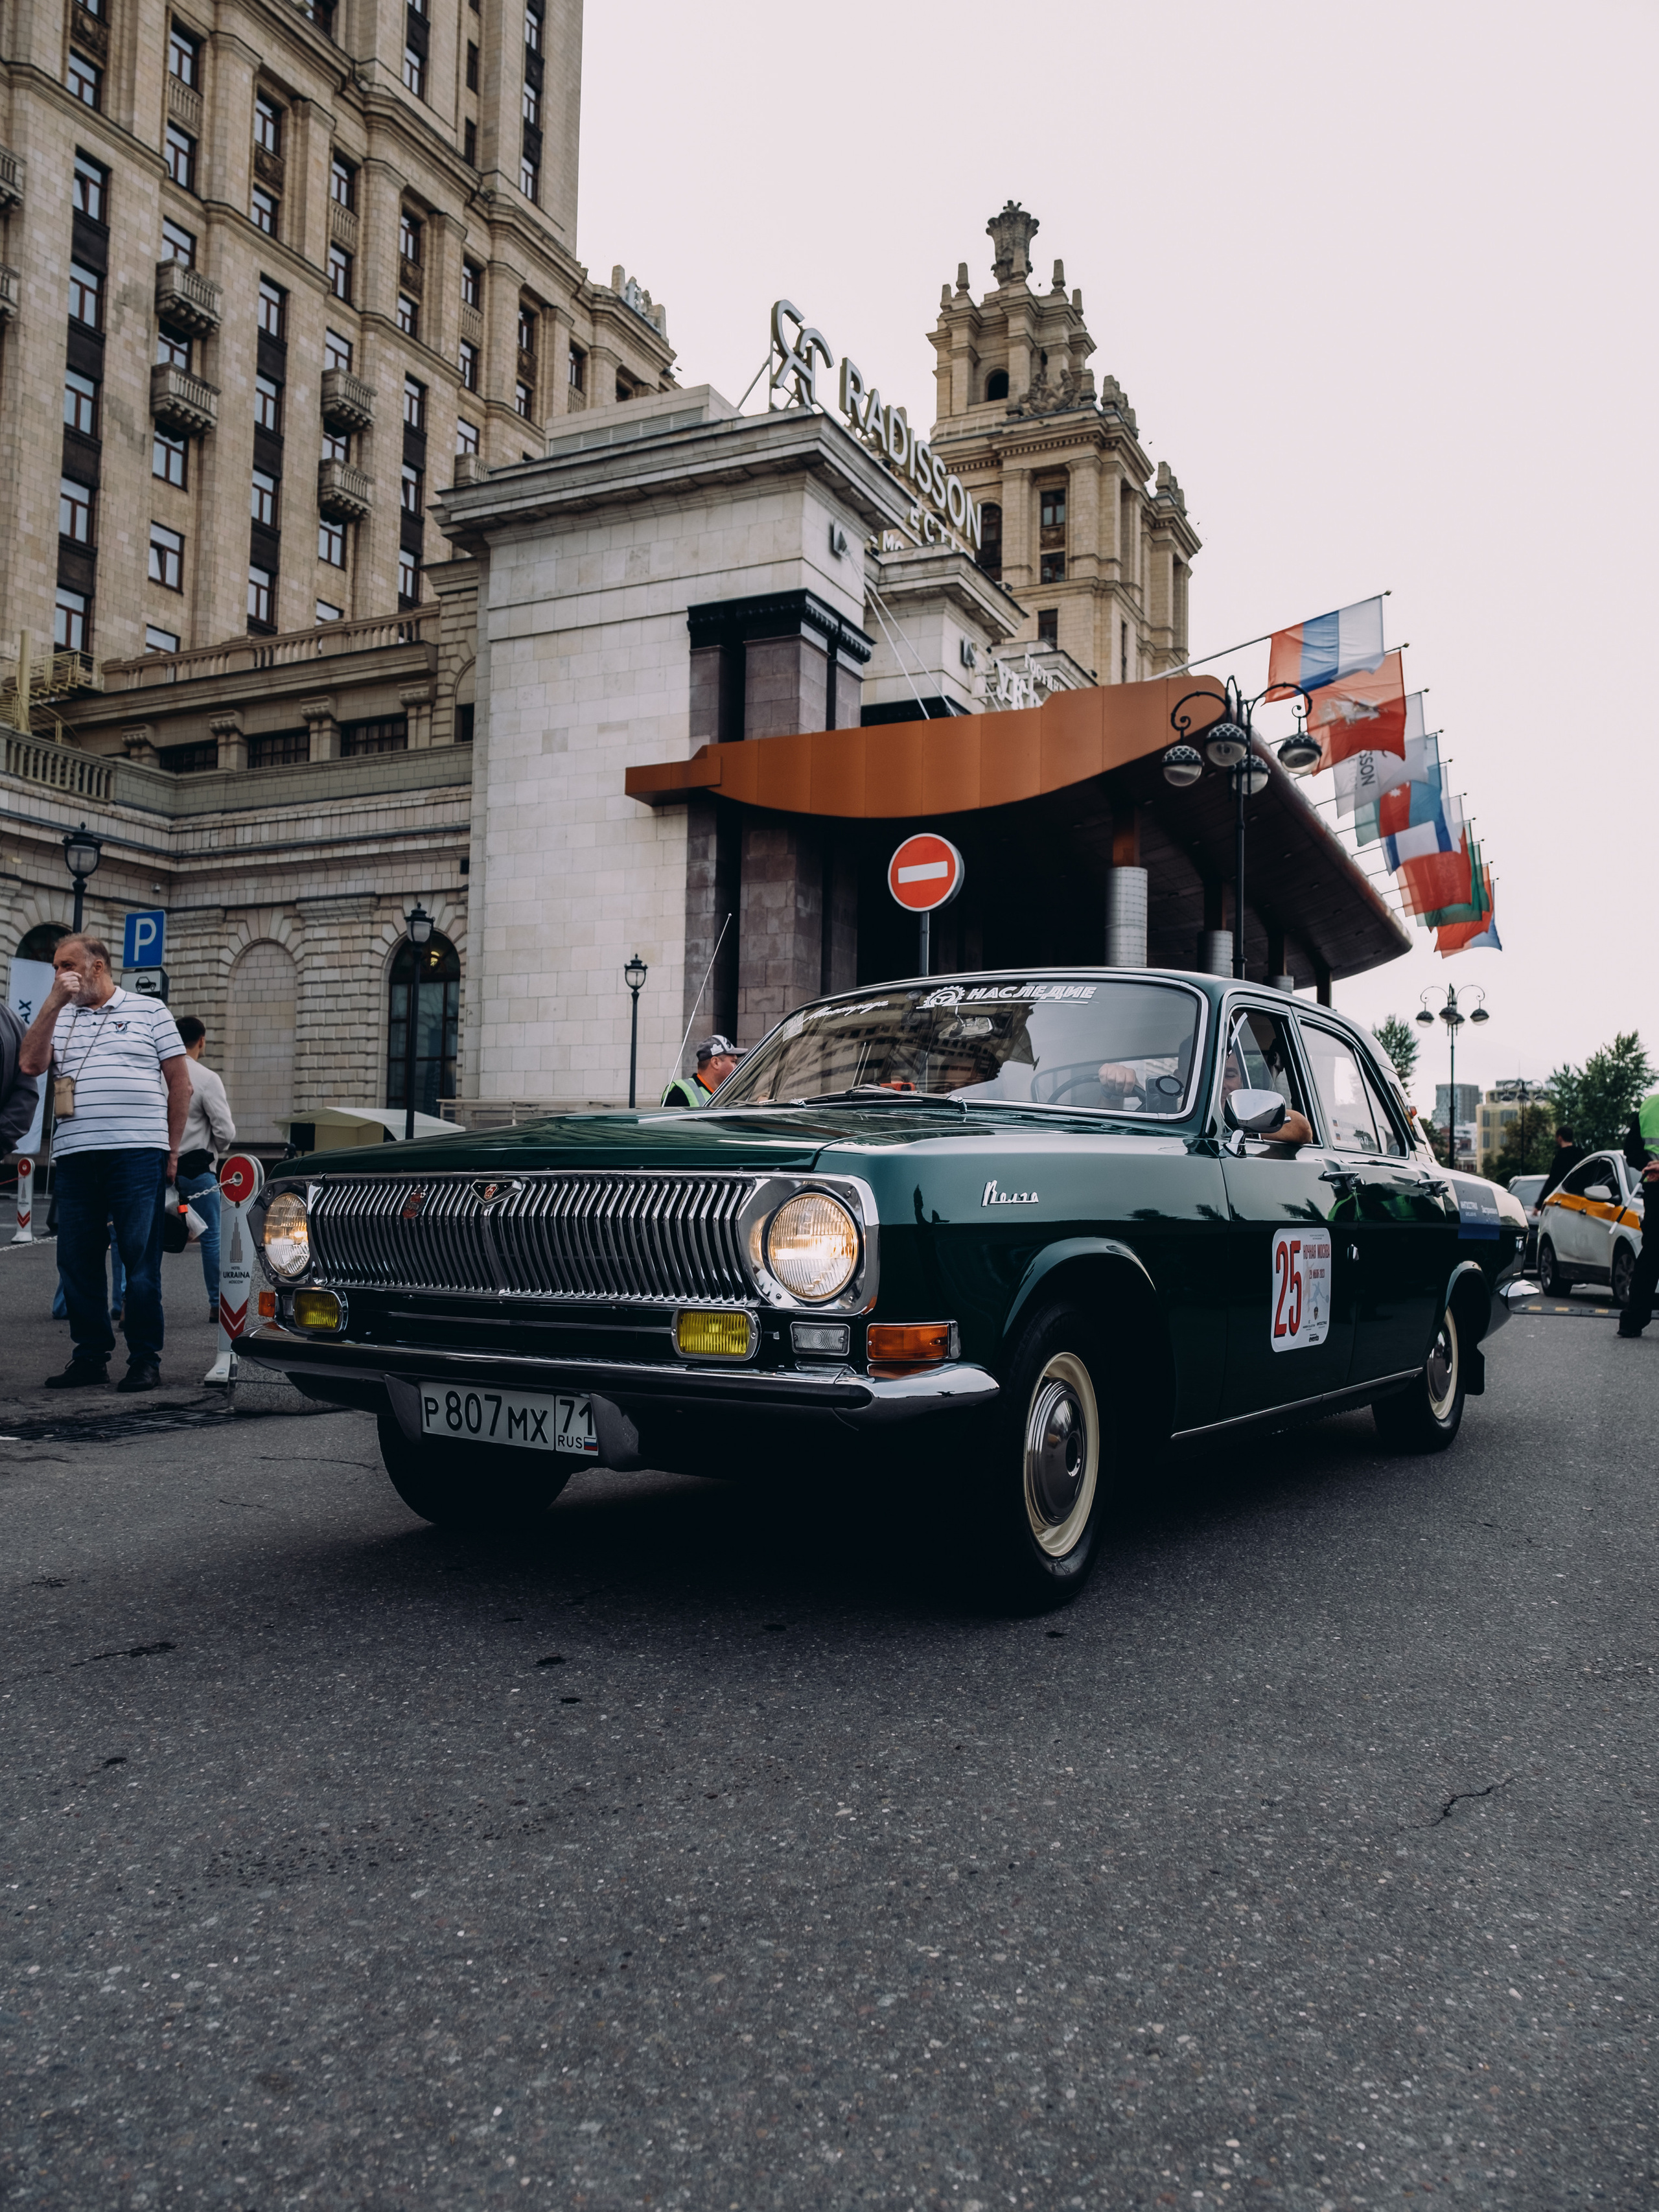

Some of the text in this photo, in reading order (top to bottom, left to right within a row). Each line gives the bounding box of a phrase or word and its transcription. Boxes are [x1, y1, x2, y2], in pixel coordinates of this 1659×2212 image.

[839, 357, 982, 550] RADISSON
[133, 918, 157, 962] P
[966, 986, 1097, 1000] НАСЛЕДИЕ
[1317, 1244, 1330, 1259] МОСКВА
[1273, 1240, 1302, 1338] 25
[559, 1399, 594, 1436] 71
[557, 1434, 583, 1449] RUS
